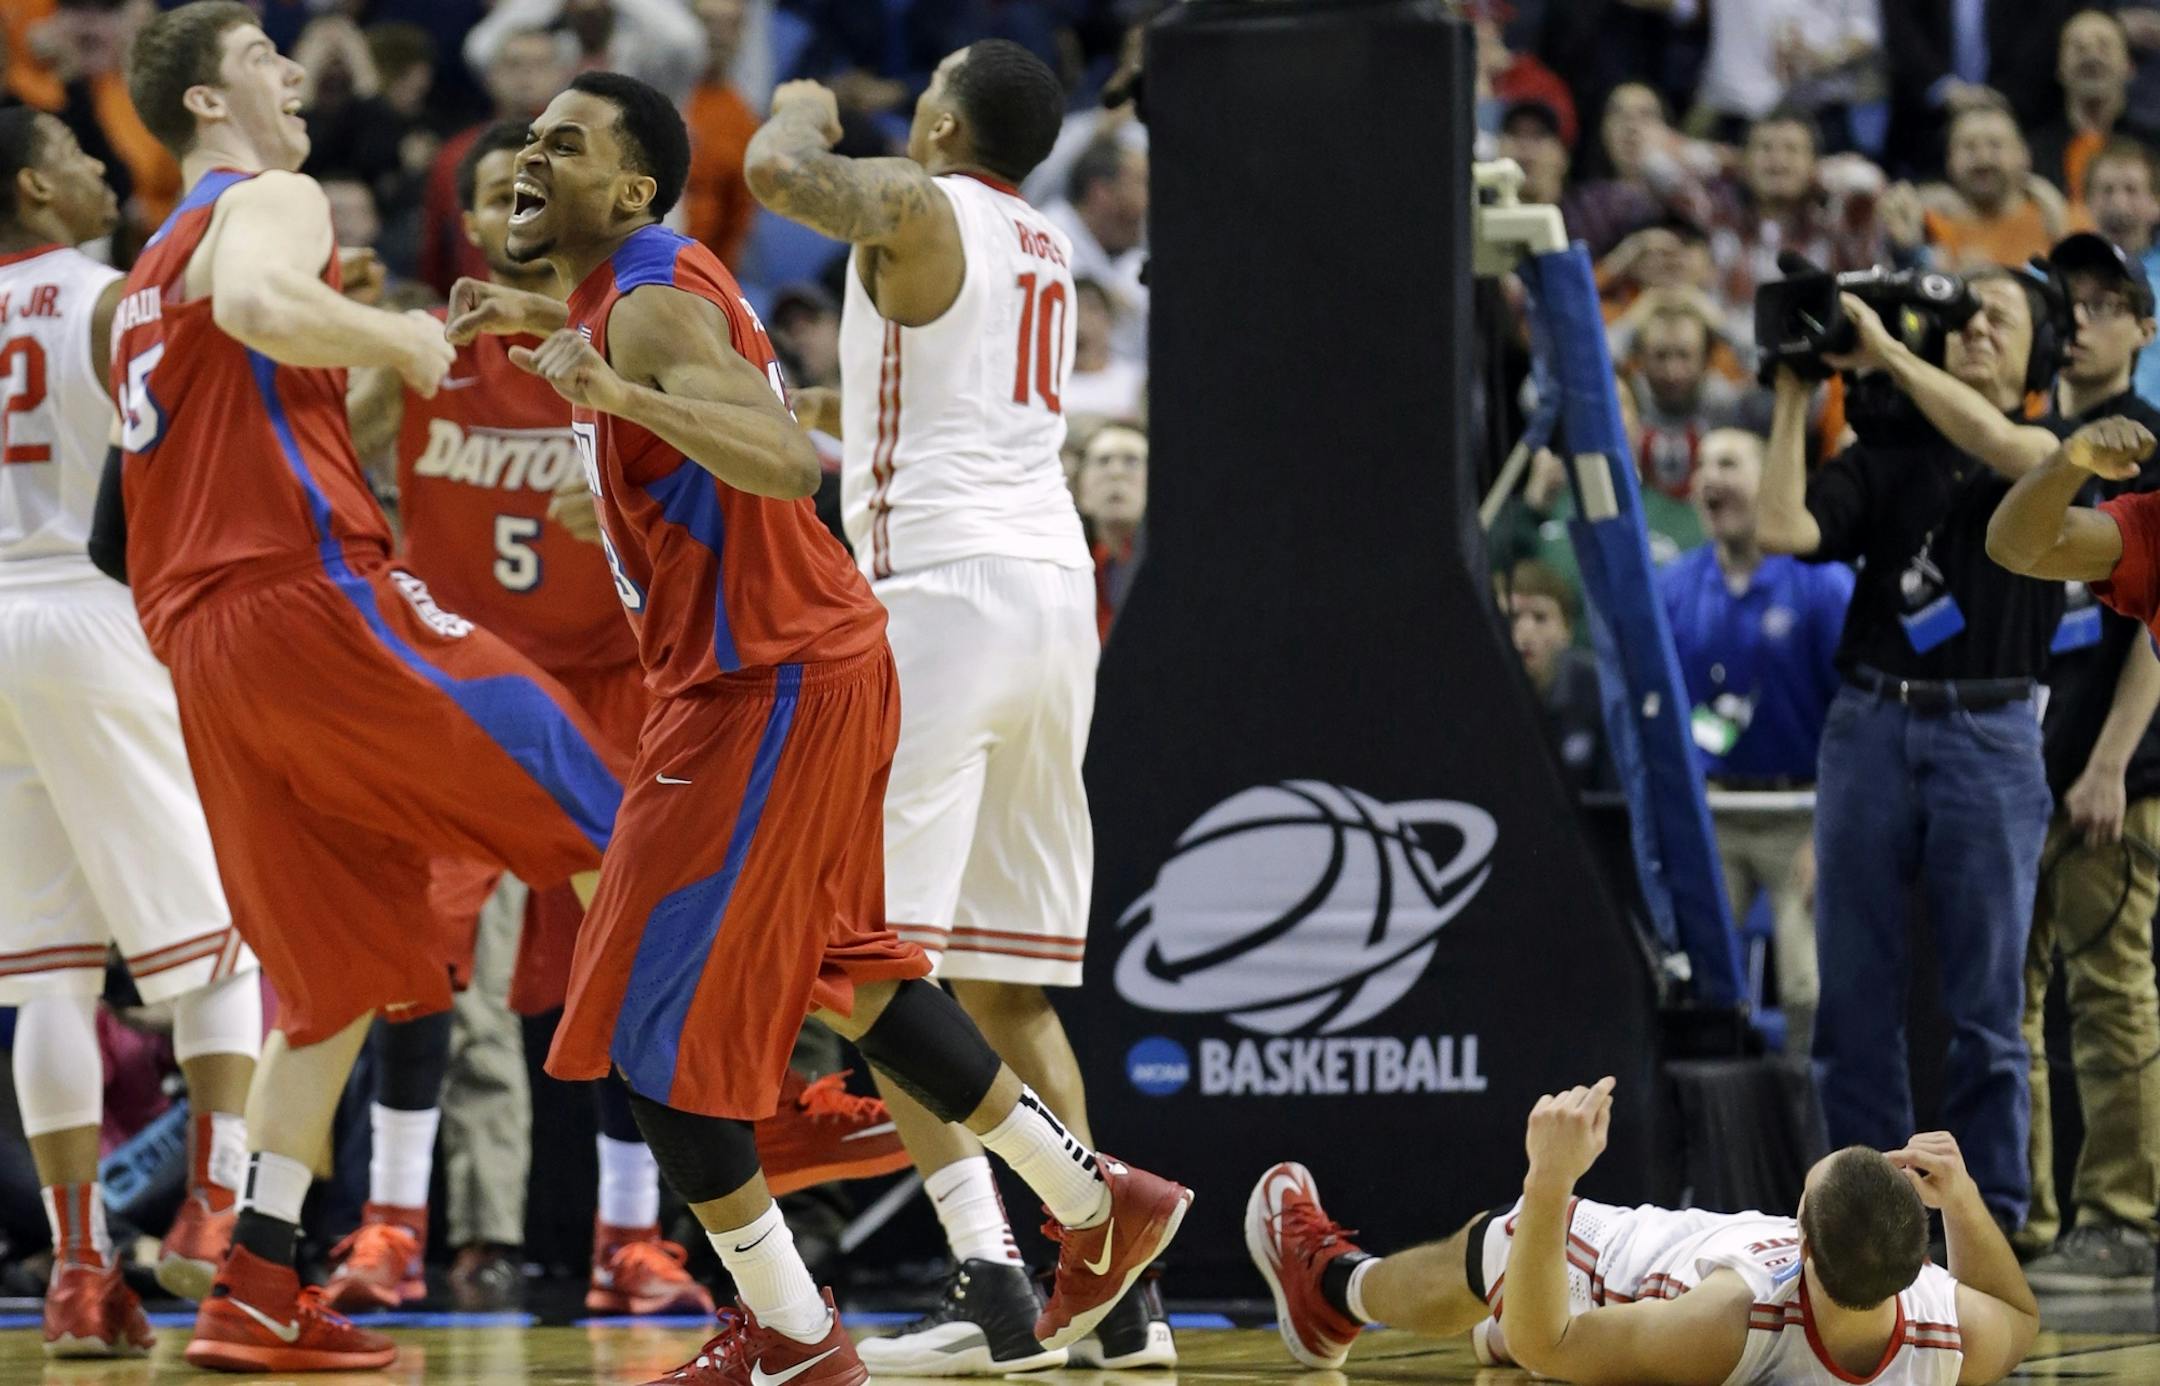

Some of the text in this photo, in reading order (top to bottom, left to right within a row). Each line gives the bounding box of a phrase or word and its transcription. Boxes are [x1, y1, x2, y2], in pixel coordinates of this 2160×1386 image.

[20, 284, 63, 319] JR.
[1013, 272, 1066, 416] 10
[493, 513, 541, 592] 5
[1200, 1034, 1488, 1096] BASKETBALL
